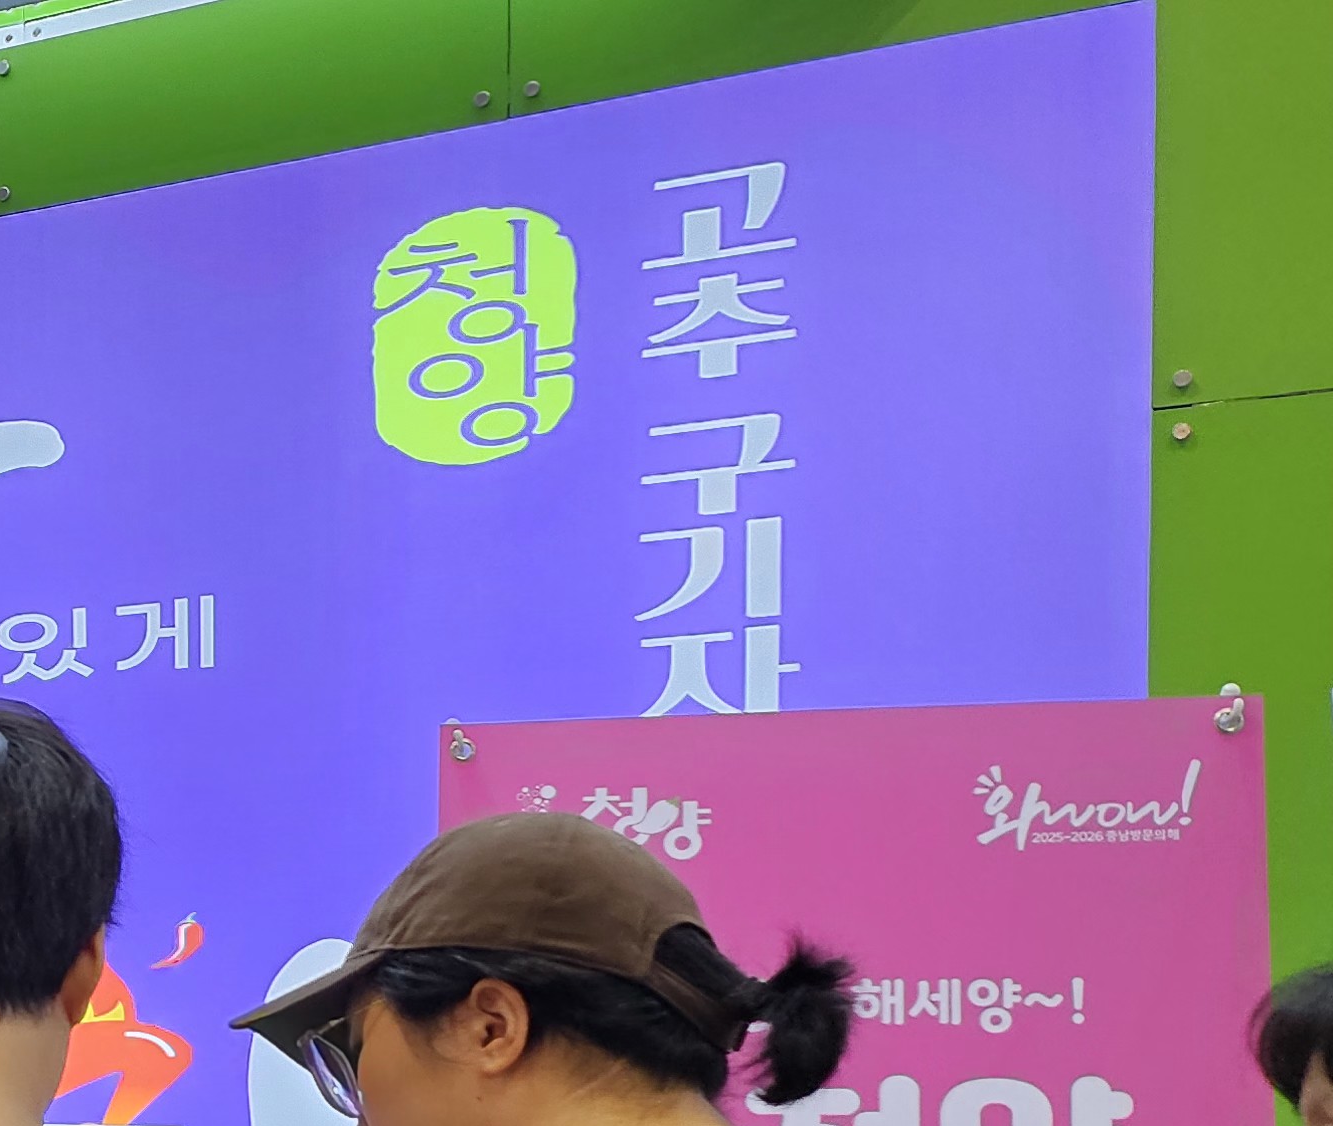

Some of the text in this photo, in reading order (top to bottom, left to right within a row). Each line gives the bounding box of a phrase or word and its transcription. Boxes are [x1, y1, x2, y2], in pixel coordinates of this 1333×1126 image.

[375, 217, 576, 450] 청양
[633, 161, 801, 717] 고추 구기자
[580, 785, 714, 861] 청양
[1031, 829, 1105, 844] 2025-2026
